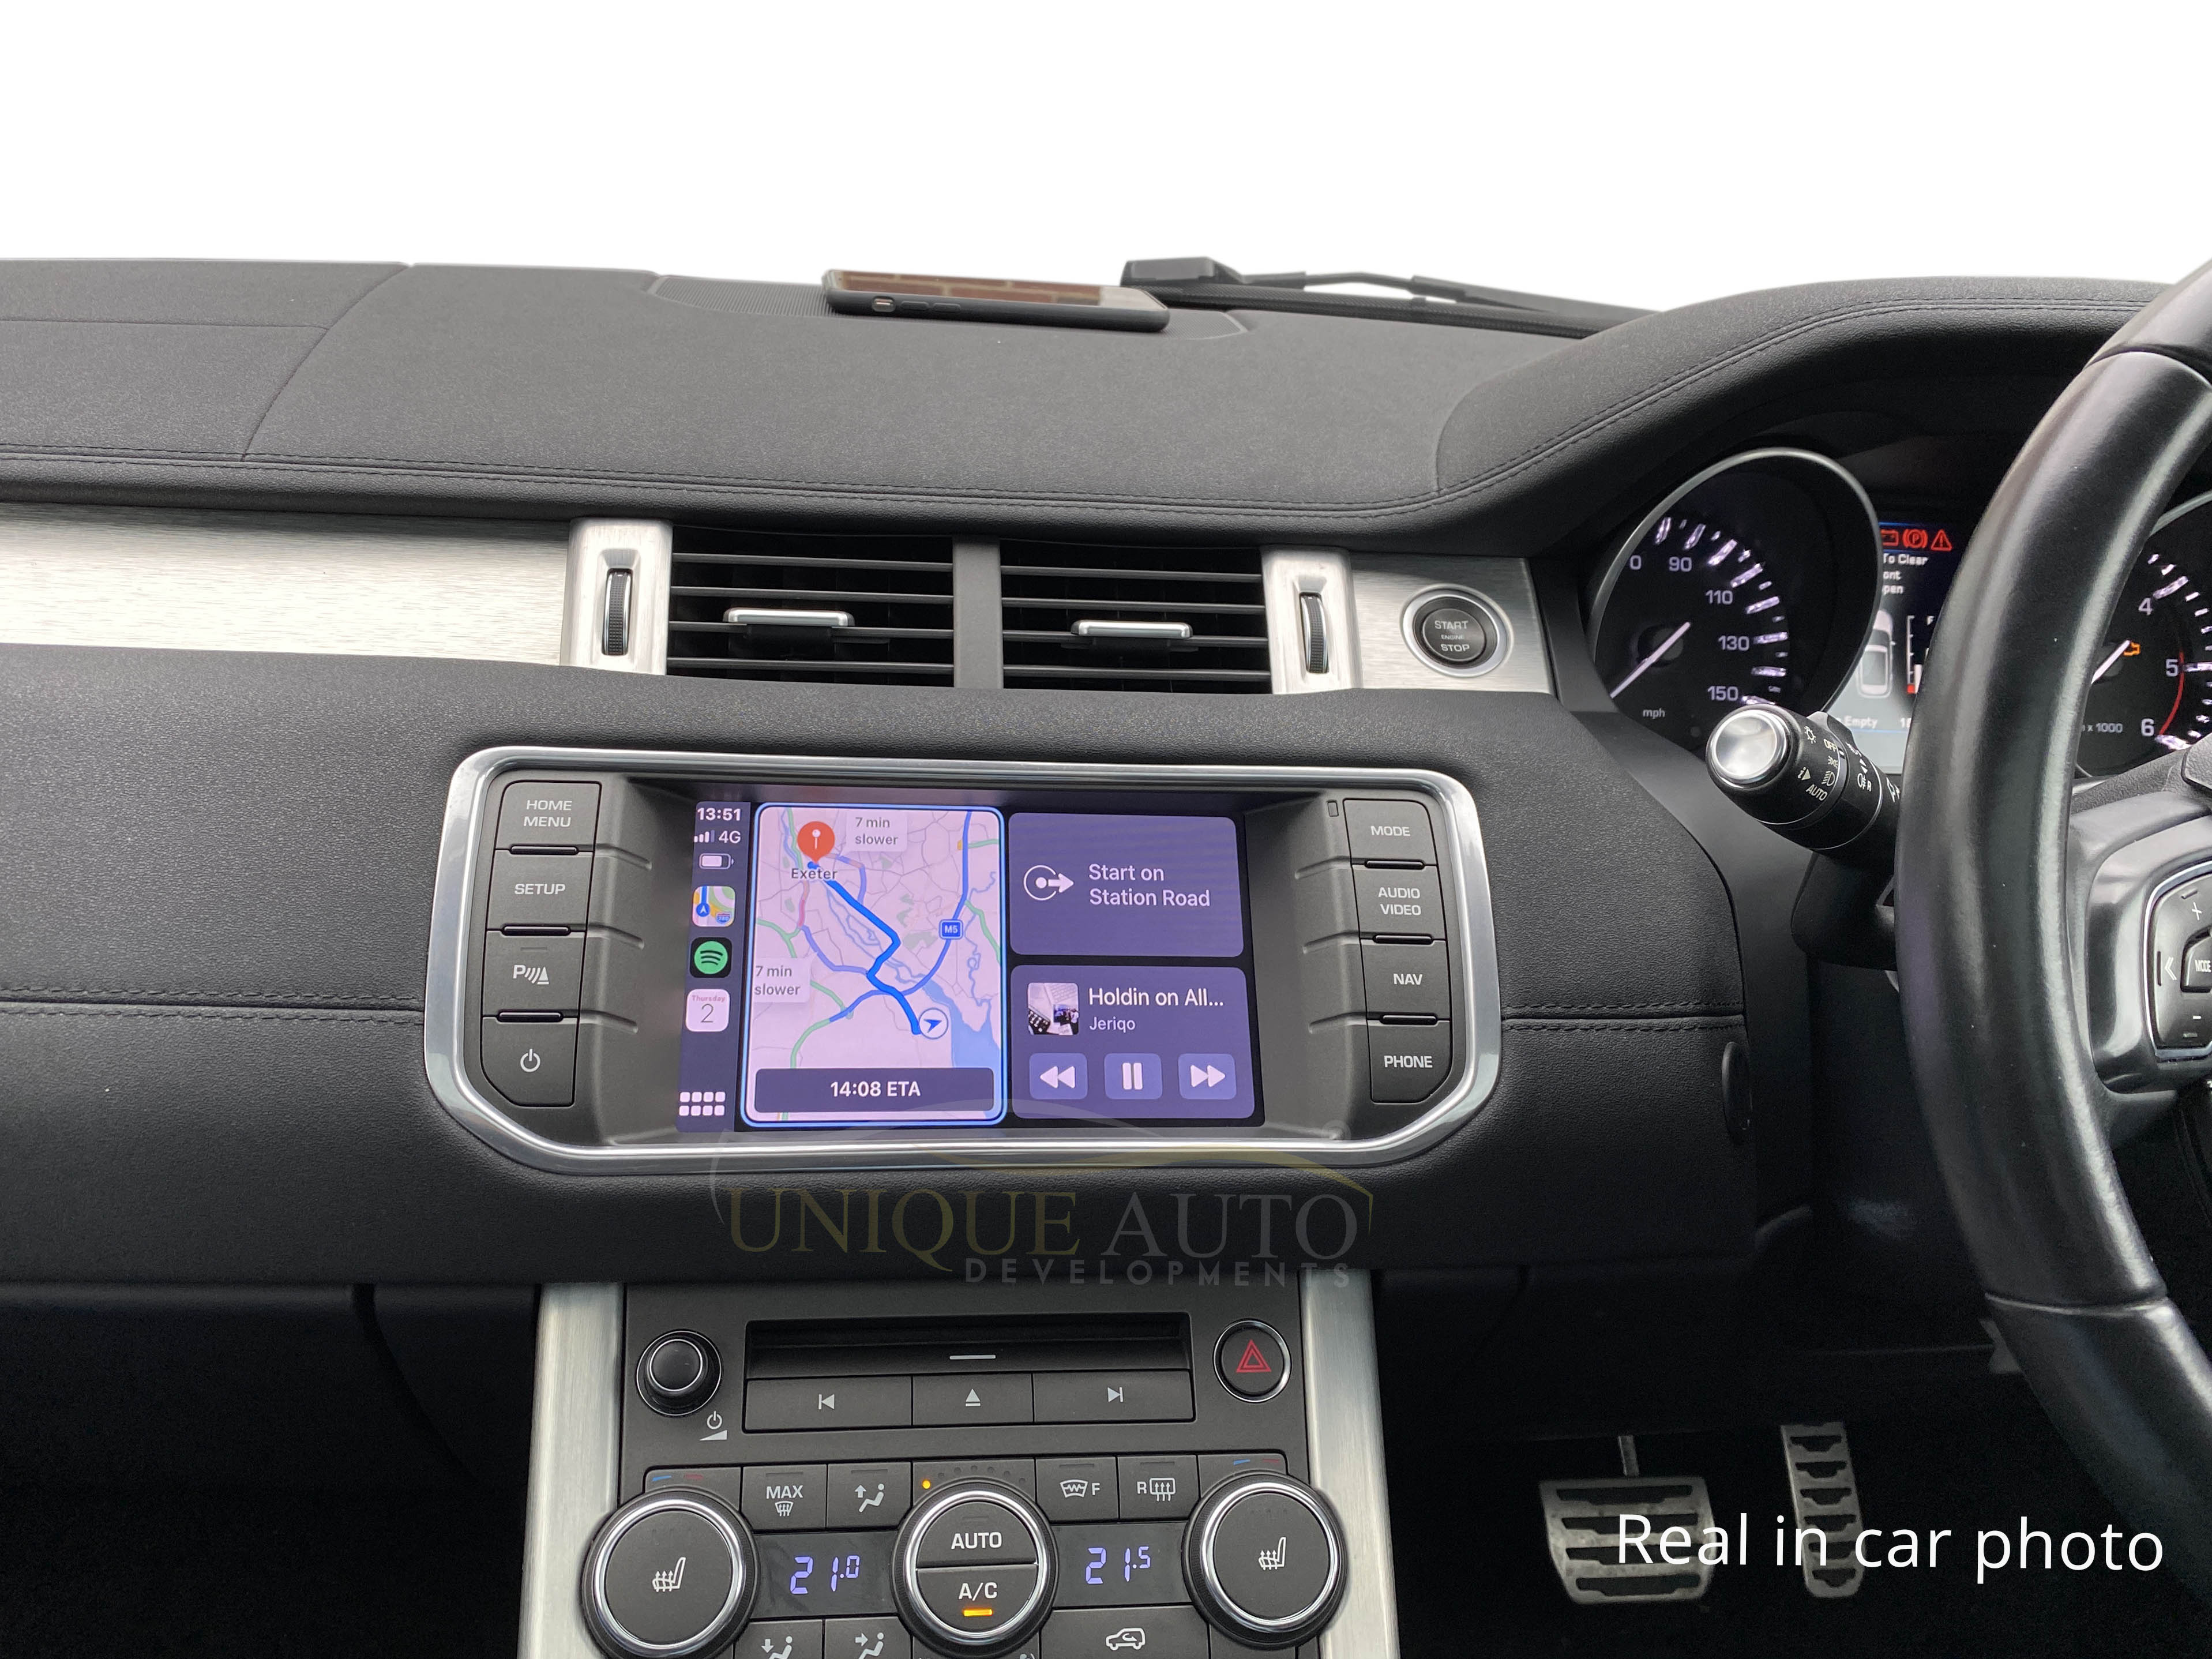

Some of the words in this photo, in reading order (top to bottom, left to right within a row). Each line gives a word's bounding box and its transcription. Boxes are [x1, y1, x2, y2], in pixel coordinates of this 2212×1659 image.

[1668, 556, 1692, 573] 90
[1897, 553, 1929, 566] Clear
[1881, 584, 1904, 596] pen
[1705, 590, 1733, 605] 110
[2138, 598, 2153, 615] 4
[1434, 620, 1469, 630] START
[1441, 643, 1470, 652] STOP
[1718, 635, 1749, 651] 130
[2165, 659, 2179, 677] 5
[1707, 686, 1739, 701] 150
[1643, 709, 1665, 719] mph
[1845, 715, 1878, 729] Empty
[2095, 723, 2123, 733] 1000
[2140, 719, 2155, 736] 6
[1823, 738, 1839, 752] OFF
[1805, 784, 1828, 801] AUTO
[526, 799, 572, 811] HOME
[697, 808, 741, 821] 13:51
[523, 816, 571, 827] MENU
[855, 817, 861, 828] 7
[866, 817, 890, 828] min
[1370, 825, 1411, 836] MODE
[719, 831, 741, 844] 4G
[855, 834, 898, 846] slower
[791, 868, 838, 880] Exeter
[1088, 863, 1136, 881] Start
[1140, 868, 1165, 881] on
[514, 883, 566, 895] SETUP
[1378, 887, 1420, 899] AUDIO
[1090, 888, 1156, 906] Station
[1162, 890, 1211, 907] Road
[1380, 904, 1421, 915] VIDEO
[944, 924, 958, 934] M5
[756, 966, 761, 977] 7
[767, 966, 792, 977] min
[2195, 959, 2211, 972] MODE
[1394, 974, 1422, 985] NAV
[754, 984, 800, 996] slower
[692, 994, 725, 1004] Thursday
[1088, 988, 1150, 1006] Holdin
[1155, 993, 1178, 1006] on
[1185, 988, 1223, 1006] All...
[701, 1004, 713, 1023] 2
[1090, 1018, 1136, 1031] Jeriqo
[1384, 1056, 1433, 1068] PHONE
[831, 1081, 881, 1097] 14:08
[887, 1081, 921, 1097] ETA
[766, 1485, 803, 1499] MAX
[1091, 1483, 1100, 1495] F
[1137, 1482, 1147, 1494] R
[951, 1532, 1002, 1549] AUTO
[1085, 1546, 1151, 1584] 21.5
[790, 1555, 860, 1594] 21.0
[958, 1582, 997, 1601] A/C
